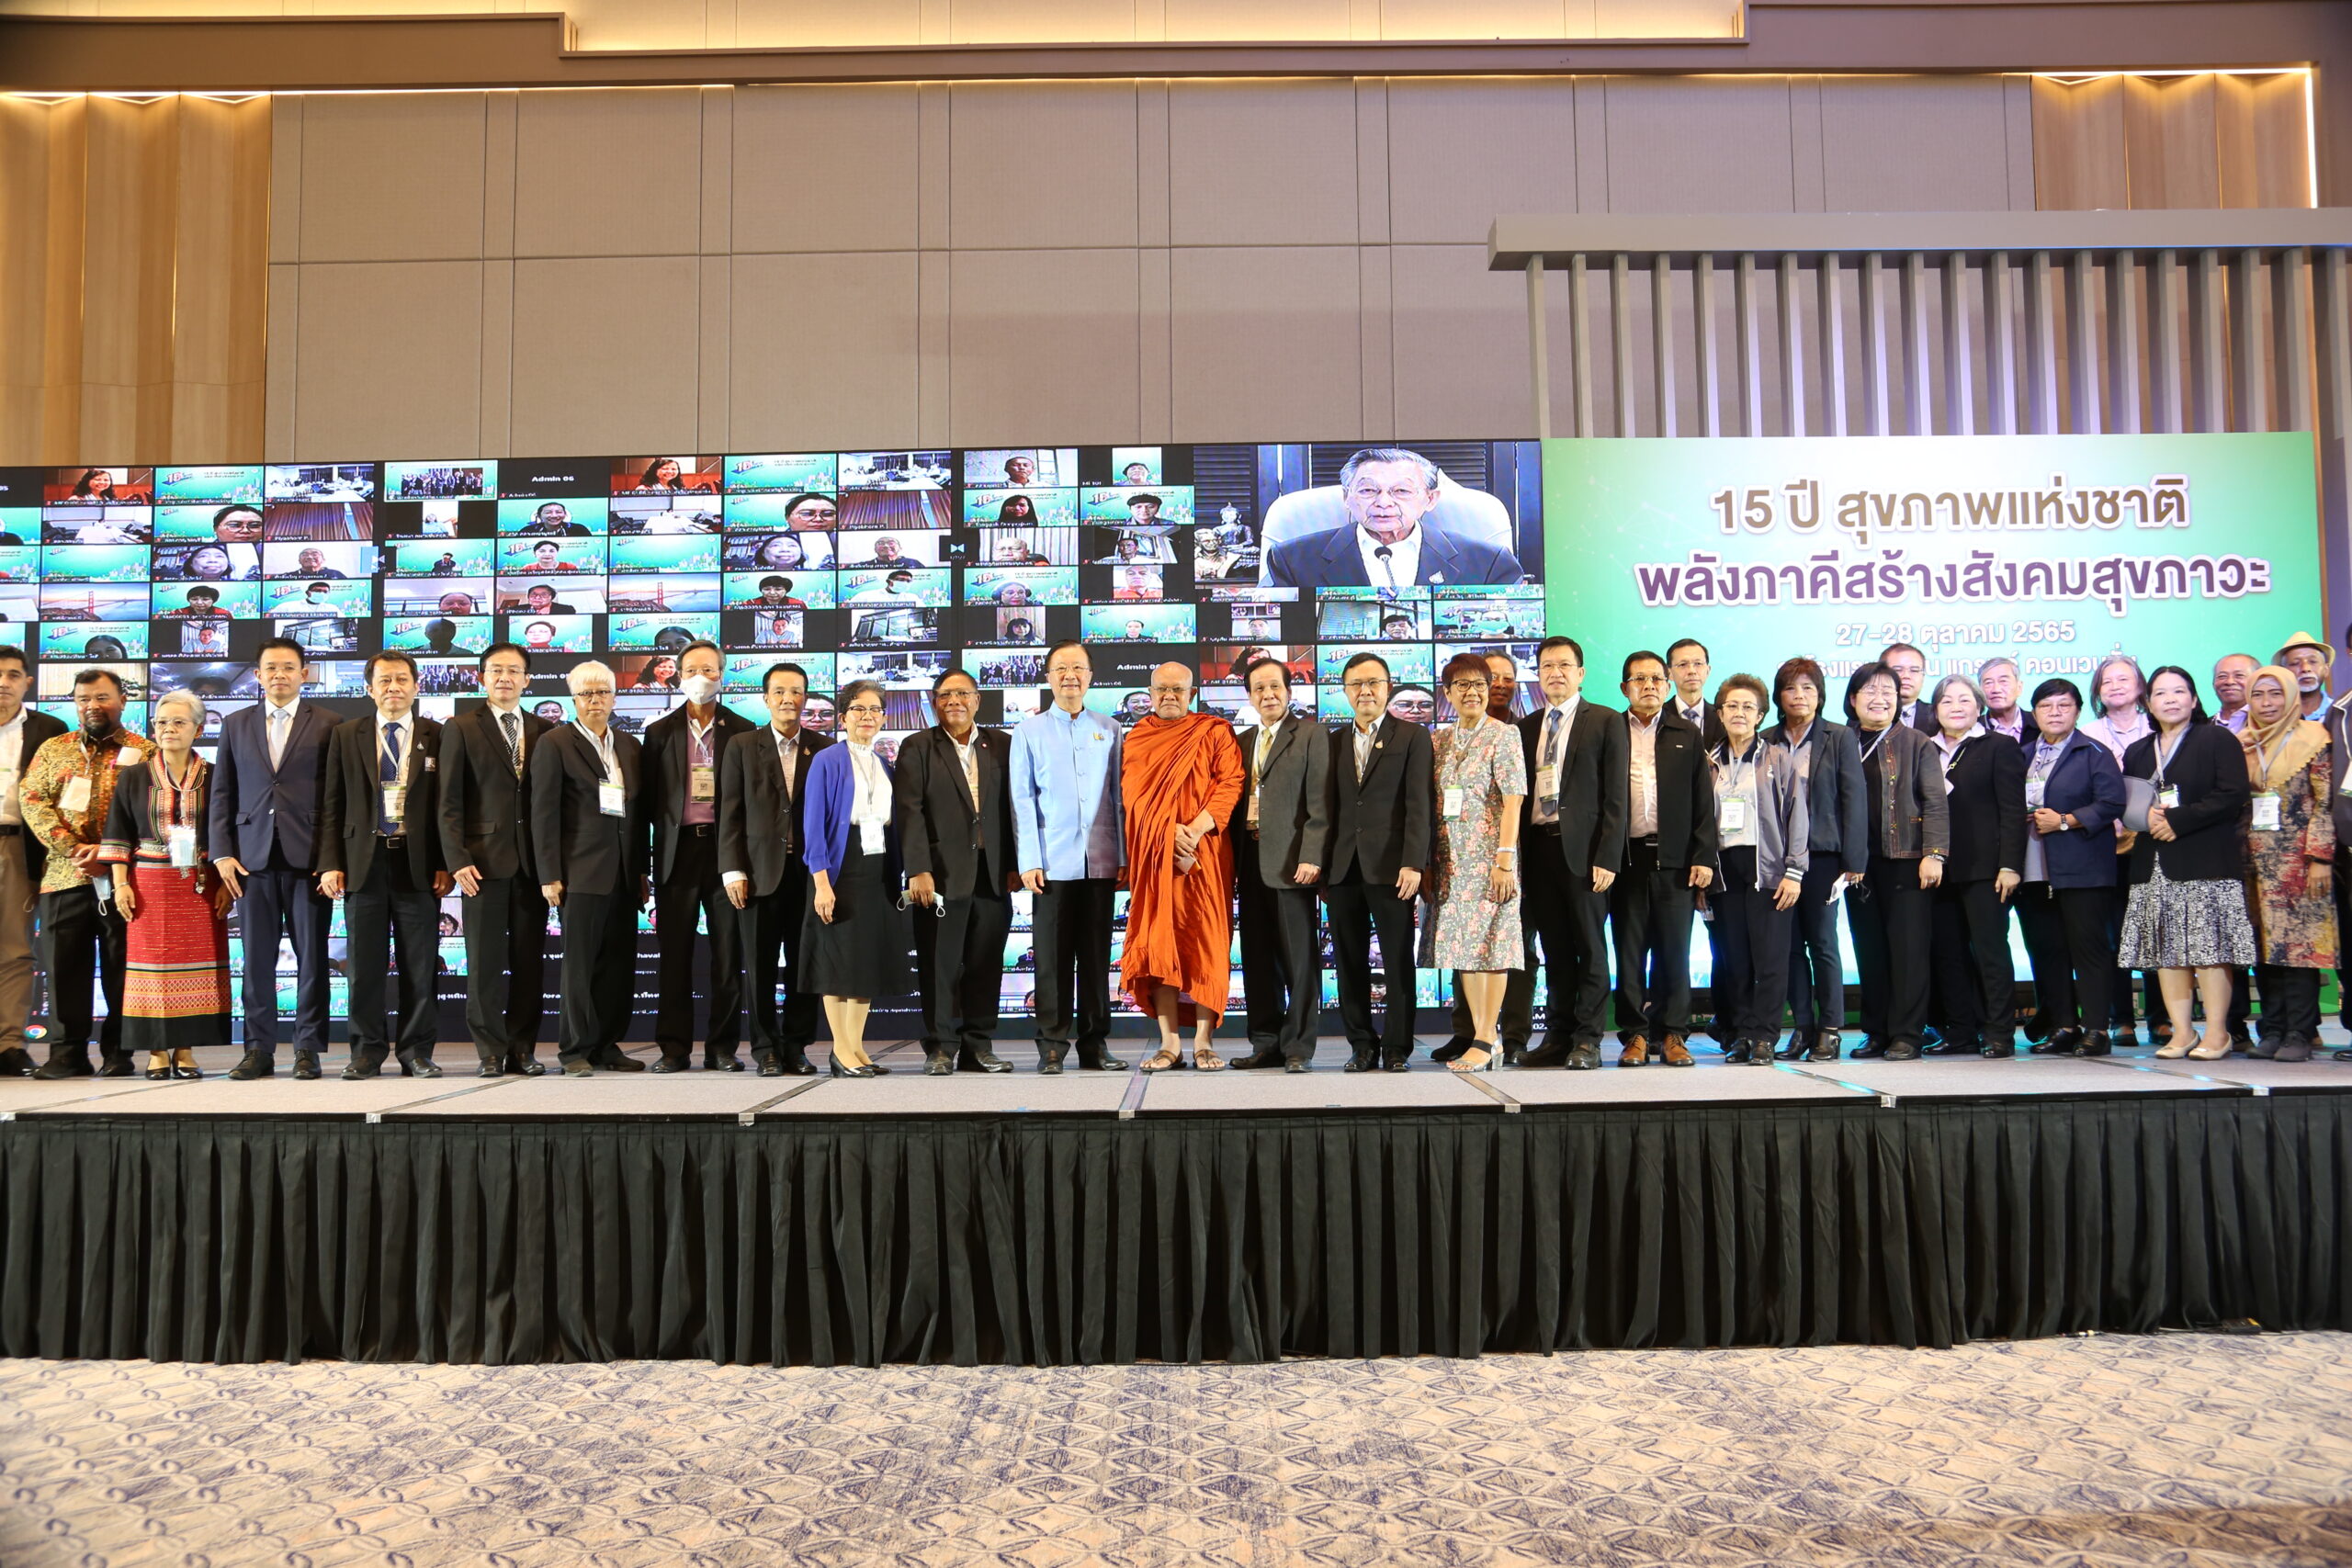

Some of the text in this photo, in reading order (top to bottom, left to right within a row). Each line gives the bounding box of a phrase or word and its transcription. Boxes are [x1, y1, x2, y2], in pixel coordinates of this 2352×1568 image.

[1714, 476, 2187, 545] 15 ปี สุขภาพแห่งชาติ
[1638, 549, 2267, 613] พลังภาคีสร้างสังคมสุขภาวะ
[1836, 619, 2076, 653] 27-28 ตุลาคม 2565
